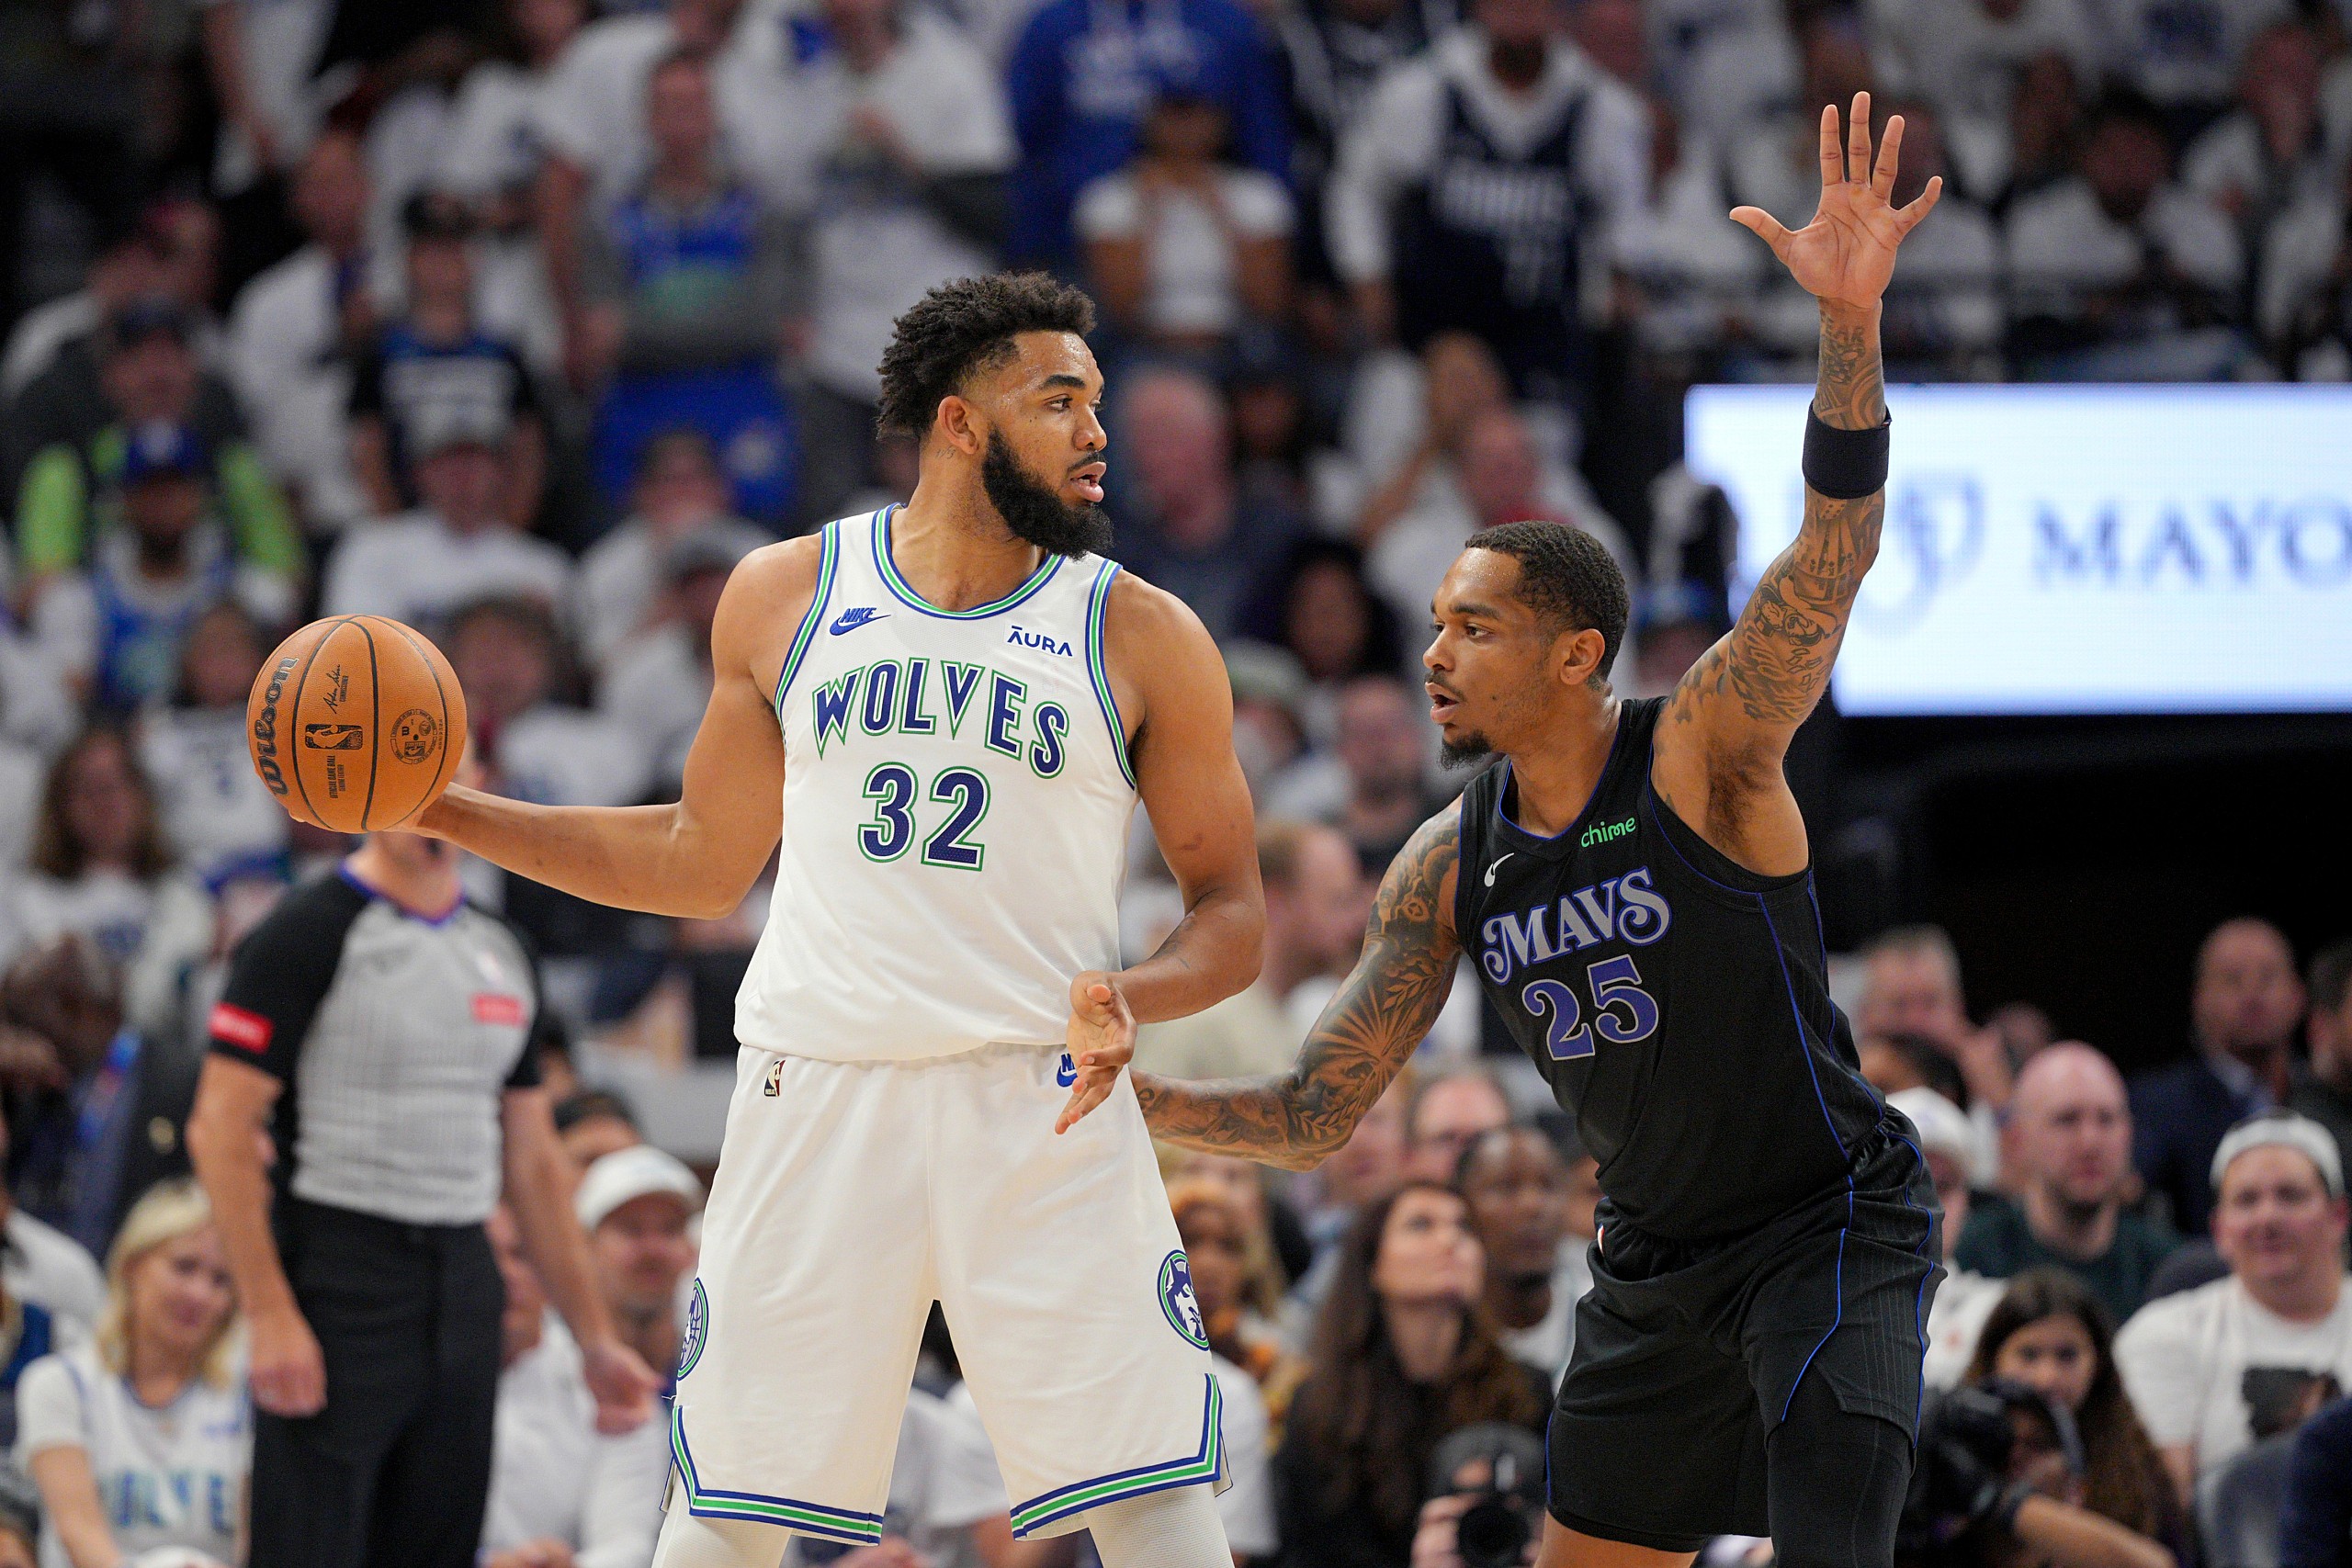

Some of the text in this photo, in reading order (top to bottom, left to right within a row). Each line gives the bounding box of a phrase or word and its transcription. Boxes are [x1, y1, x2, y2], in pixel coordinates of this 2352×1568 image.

[2031, 497, 2352, 590] MAYO
[838, 606, 877, 624] NIKE
[254, 657, 300, 796] Wilson
[812, 657, 1069, 779] WOLVES
[857, 761, 991, 872] 32
[1580, 817, 1636, 848] chime
[1481, 865, 1672, 986] MAVS
[1521, 953, 1659, 1061] 25
